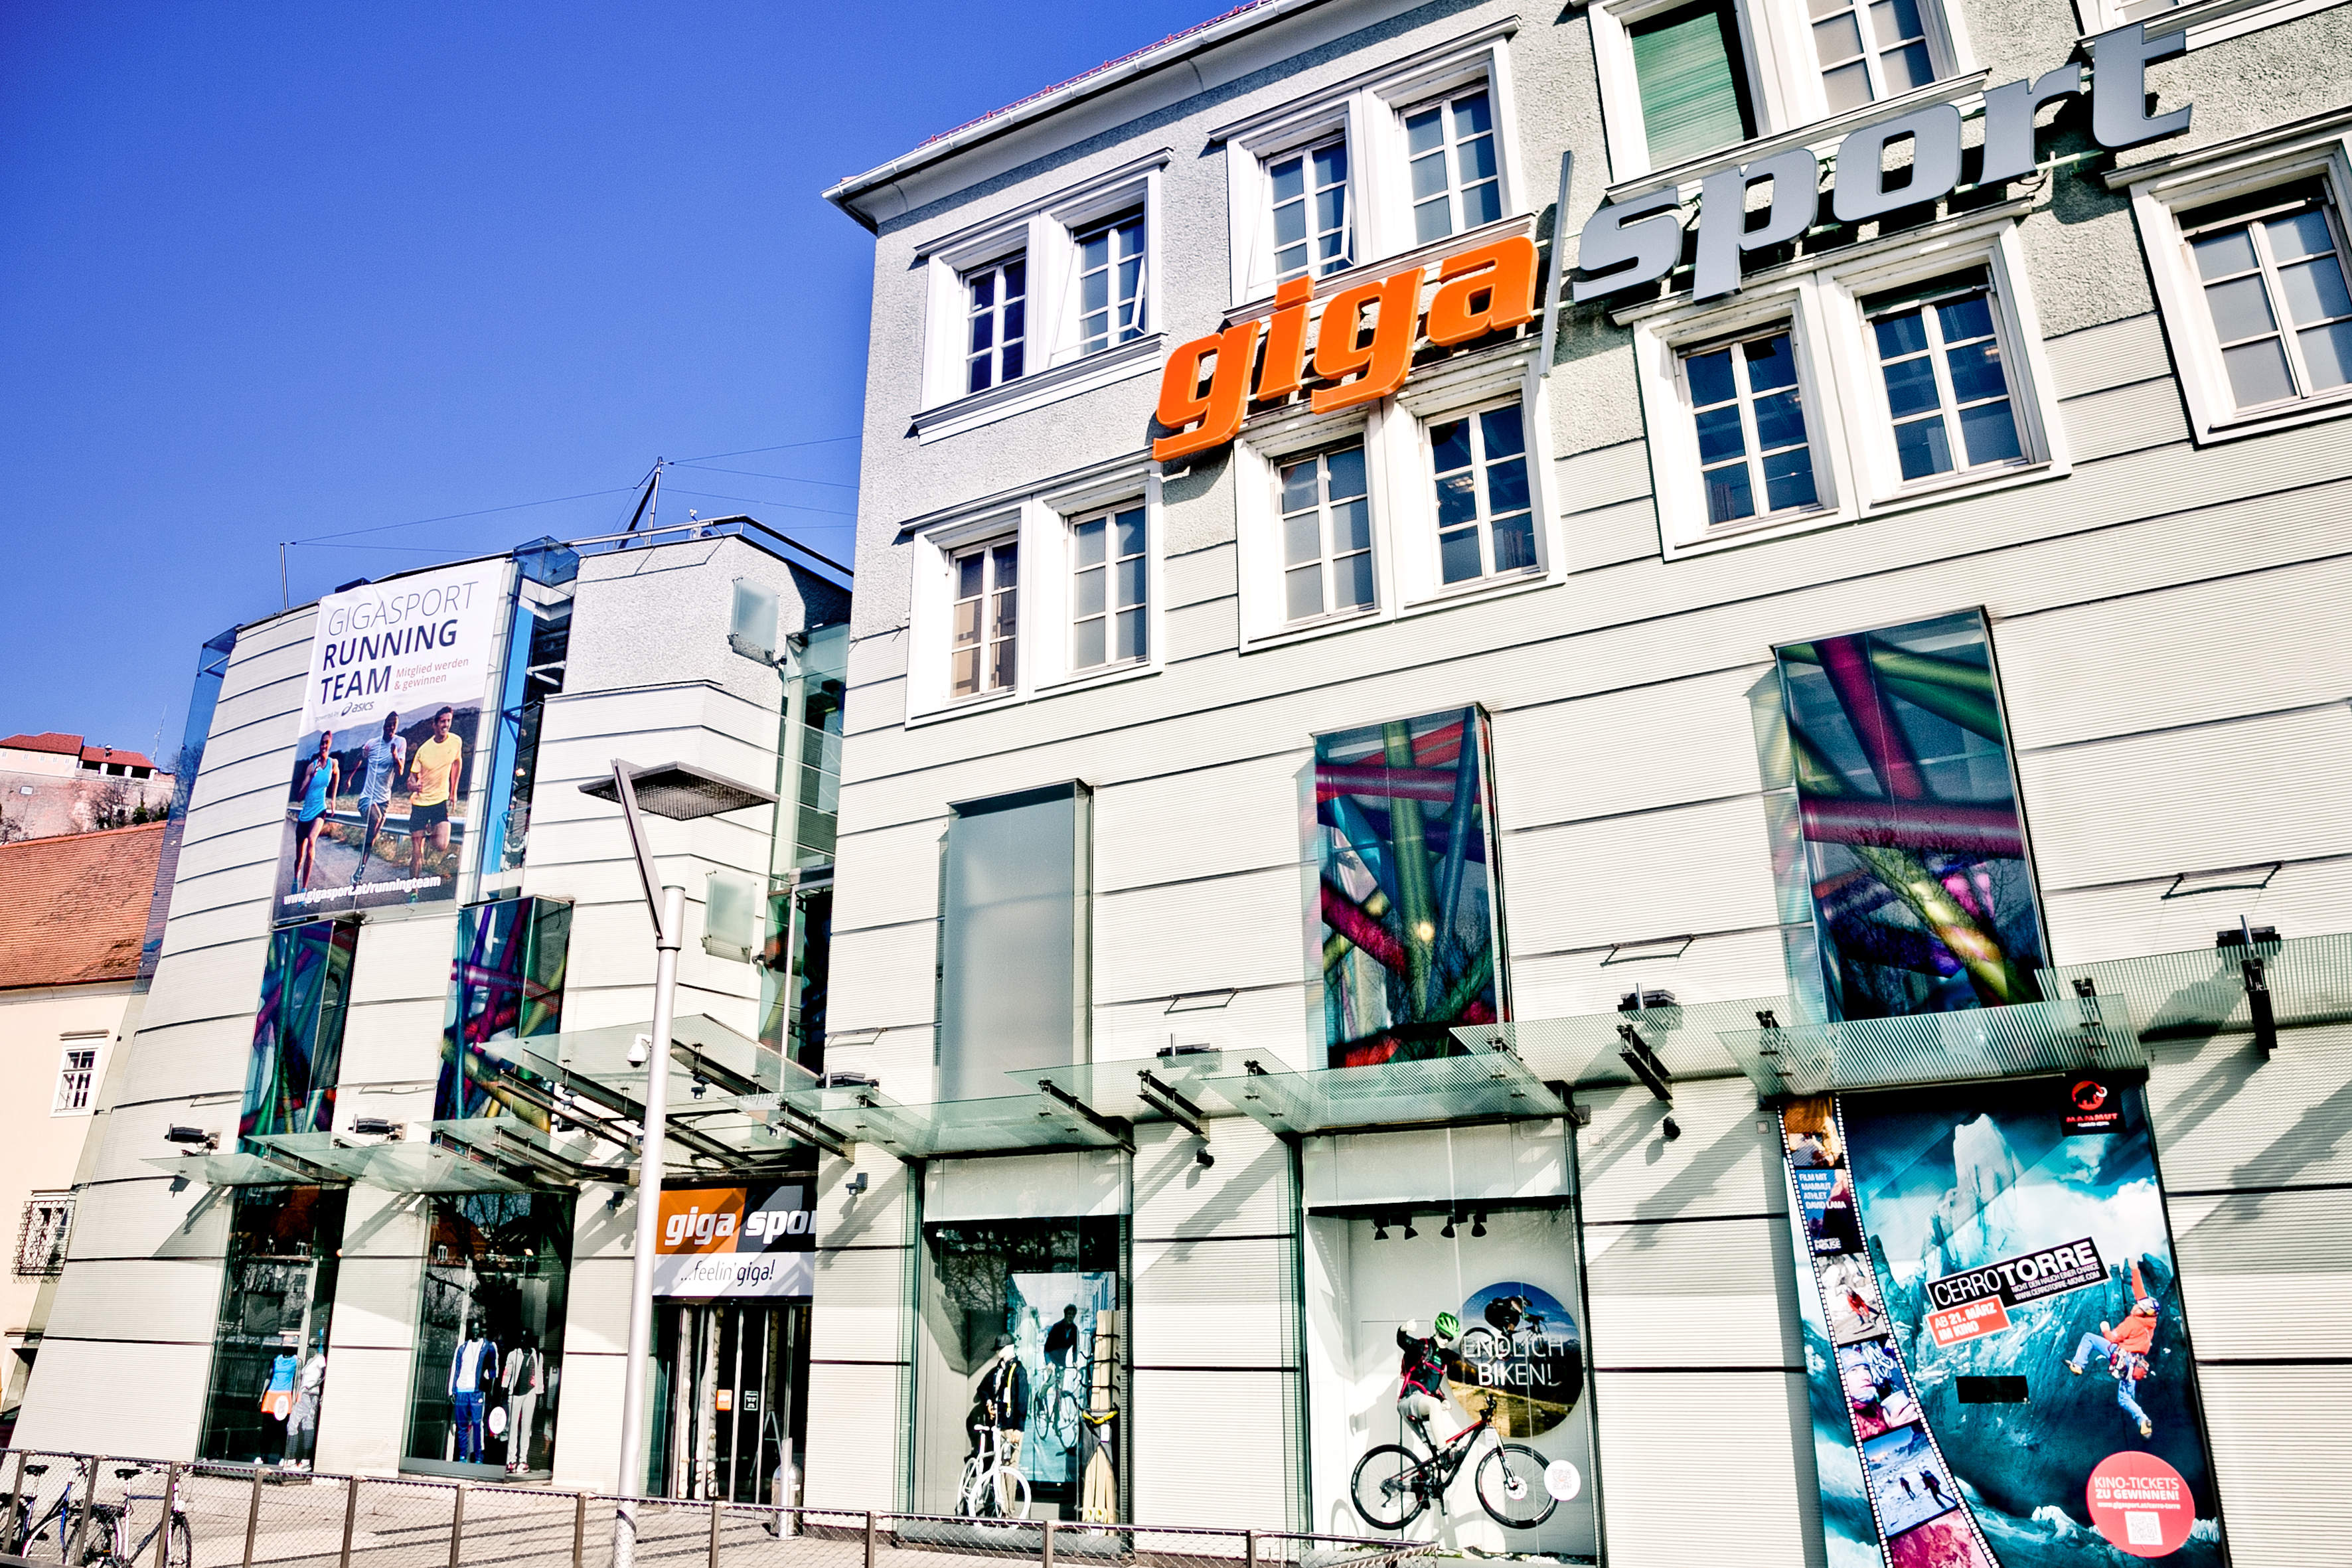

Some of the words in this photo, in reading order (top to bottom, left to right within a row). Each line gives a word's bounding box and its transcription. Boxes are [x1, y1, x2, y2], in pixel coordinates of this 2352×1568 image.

[1152, 236, 1539, 463] giga
[1571, 22, 2193, 304] sport
[329, 581, 479, 636] GIGASPORT
[323, 619, 458, 671] RUNNING
[394, 681, 401, 690] &
[402, 673, 447, 692] gewinnen
[396, 663, 432, 680] Mitglied
[434, 658, 469, 671] werden
[321, 665, 392, 704] TEAM
[283, 876, 441, 905] www.gigasport.at/runningteam
[2066, 1113, 2118, 1123] MAMMUT
[664, 1206, 736, 1246] giga
[737, 1259, 775, 1287] giga!
[2011, 1282, 2028, 1293] NICHT
[2029, 1278, 2041, 1289] DEN
[2059, 1268, 2077, 1281] EINER
[2076, 1262, 2100, 1274] CHANCE
[1934, 1315, 1948, 1329] AB
[1948, 1311, 1966, 1324] 21.
[1964, 1302, 1998, 1321] MÄRZ
[1938, 1328, 1954, 1341] IM
[1952, 1320, 1980, 1338] KINO
[1463, 1334, 1564, 1360] ENDLICH
[1478, 1363, 1551, 1386] BIKEN!
[2094, 1476, 2180, 1490] KINO-TICKETS
[2095, 1488, 2111, 1499] ZU
[2113, 1489, 2180, 1500] GEWINNEN!
